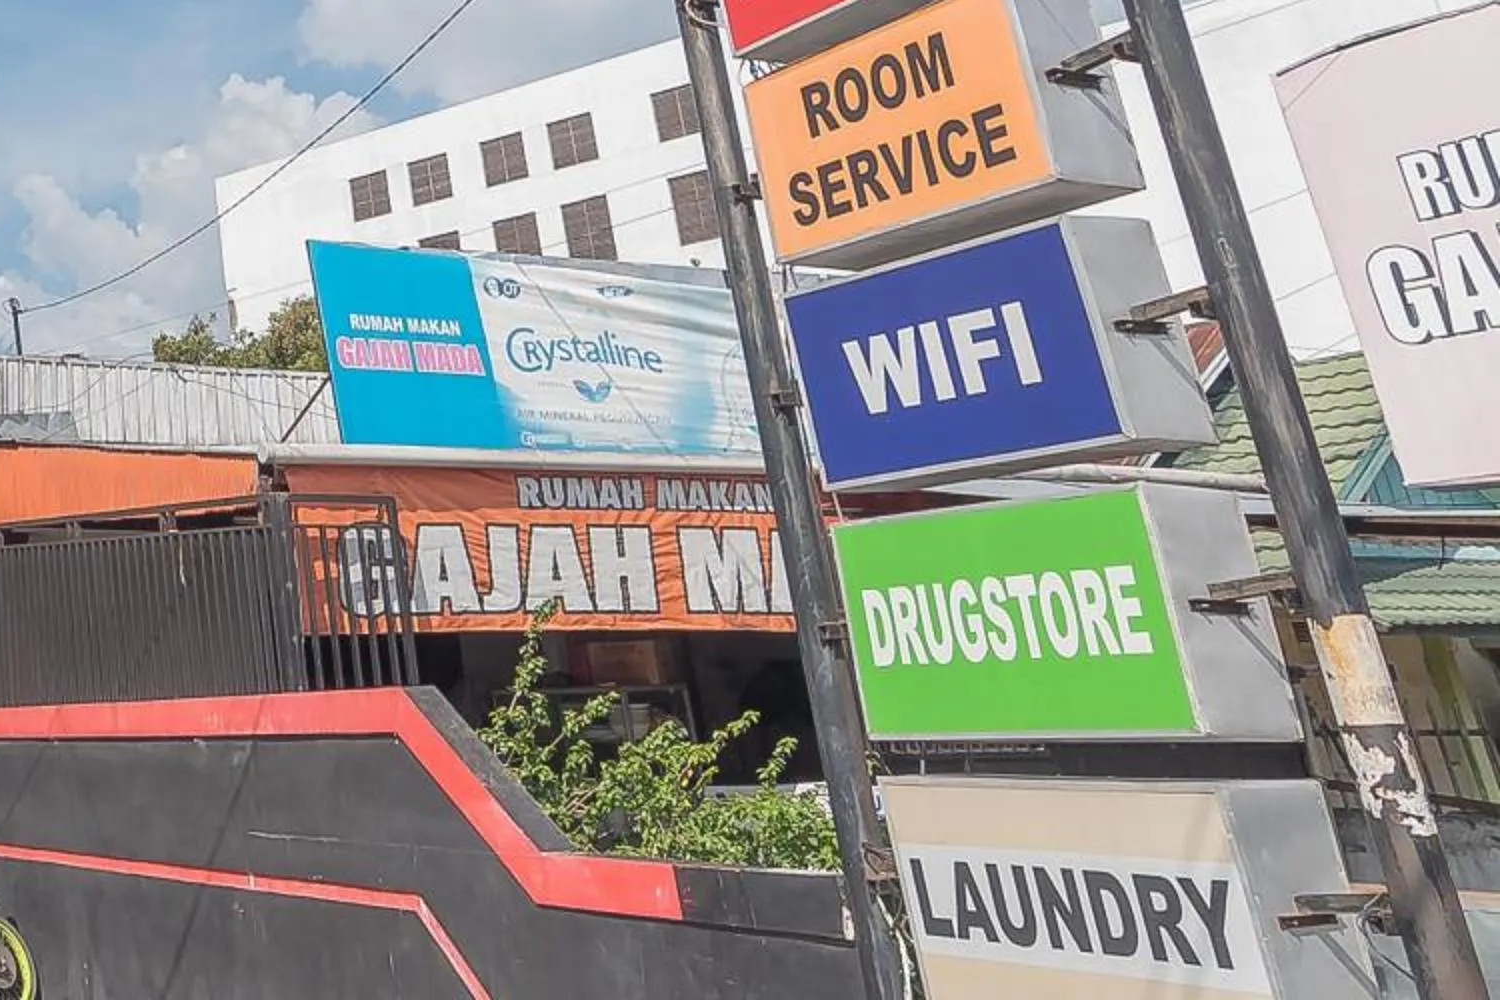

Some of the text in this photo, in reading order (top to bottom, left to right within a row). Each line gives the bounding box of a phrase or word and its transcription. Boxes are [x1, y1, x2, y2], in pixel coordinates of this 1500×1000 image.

[799, 31, 956, 138] ROOM
[787, 103, 1018, 228] SERVICE
[1396, 128, 1500, 222] RU
[349, 313, 461, 336] RUMAH MAKAN
[1365, 222, 1500, 345] GA
[336, 336, 486, 376] GAJAH MADA
[842, 301, 1043, 414] WIFI
[516, 476, 775, 513] RUMAH MAKAN
[861, 565, 1154, 668] DRUGSTORE
[908, 858, 1235, 970] LAUNDRY
